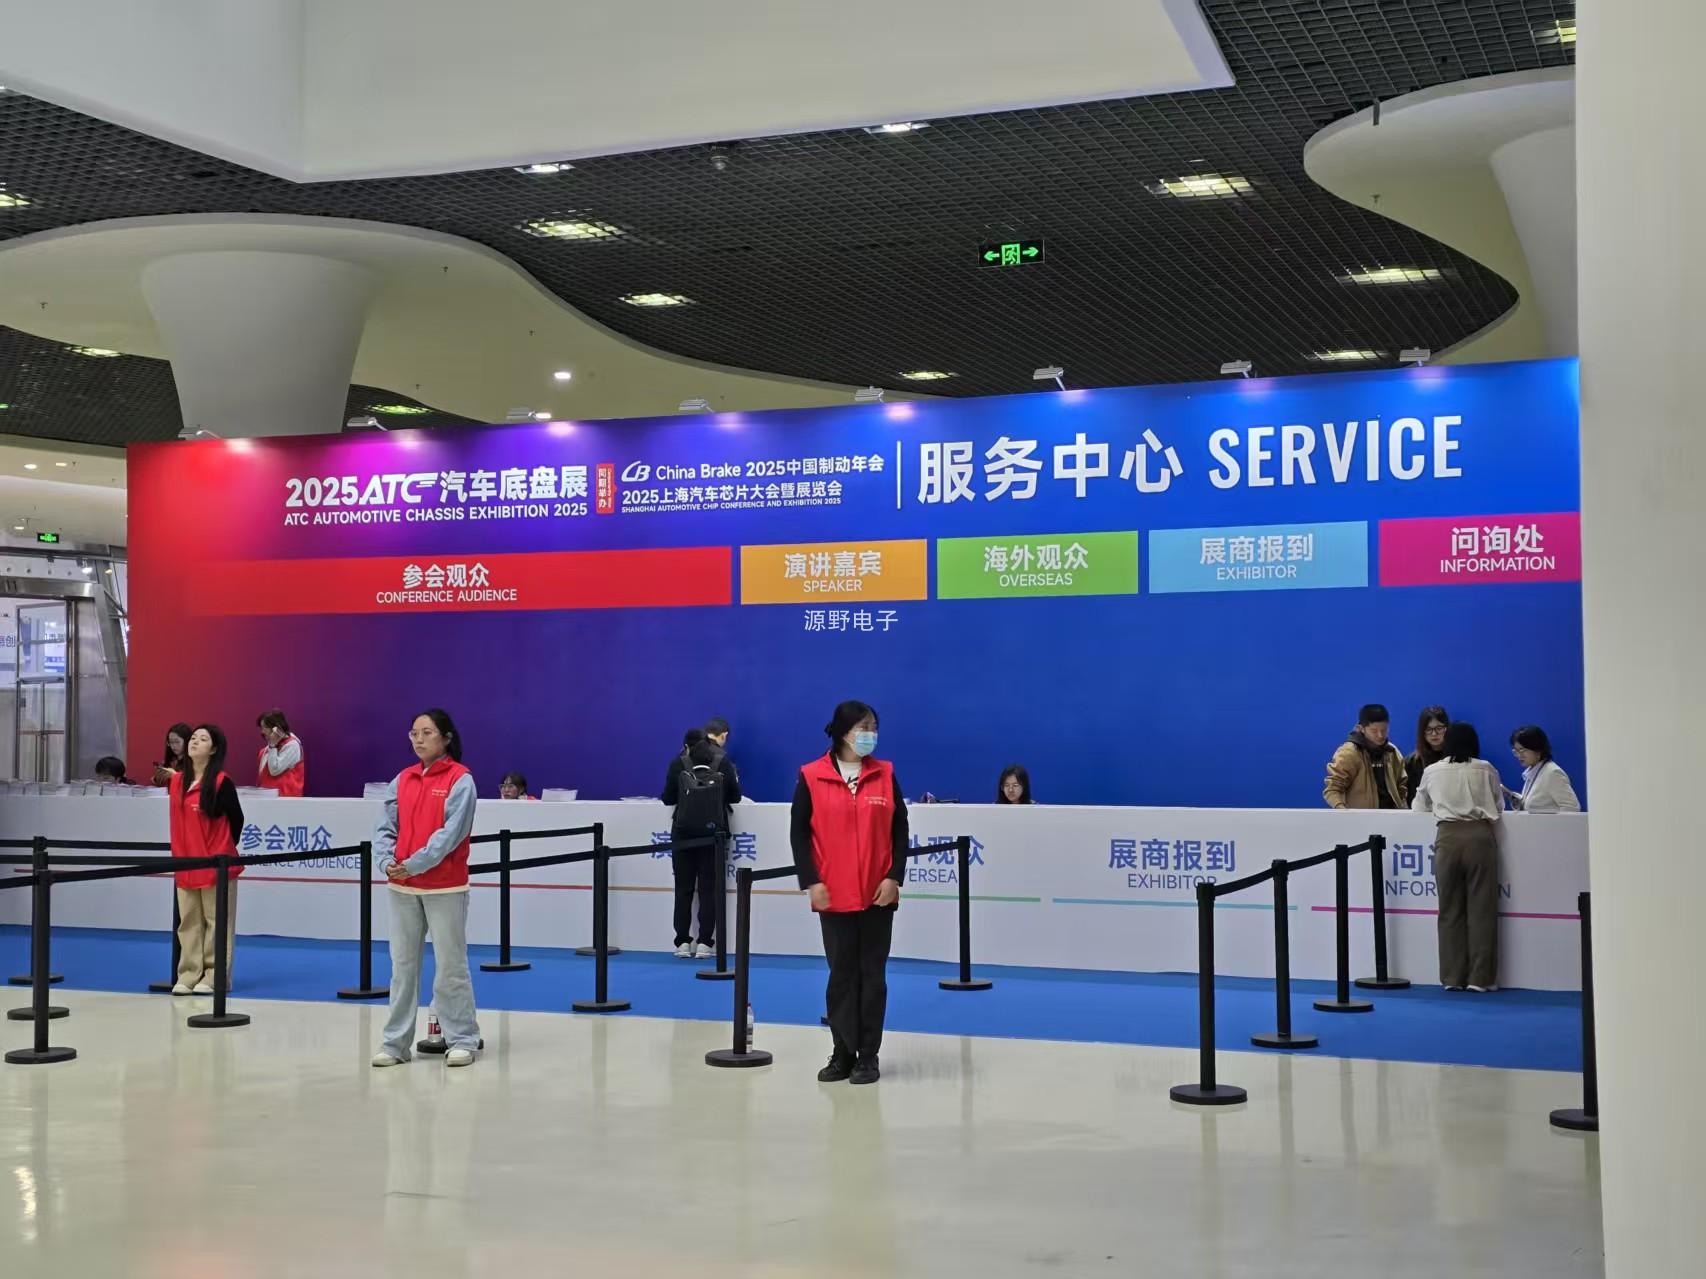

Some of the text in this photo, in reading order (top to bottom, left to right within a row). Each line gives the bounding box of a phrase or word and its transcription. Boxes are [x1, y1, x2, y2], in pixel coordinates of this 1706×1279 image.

[656, 464, 696, 480] China
[700, 462, 741, 478] Brake
[746, 454, 885, 477] 2025中国制动年会
[917, 415, 1462, 504] 服务中心 SERVICE
[621, 497, 841, 513] SHANGHAI AUTOMOTIVE CHIP CONFERENCE AND EXHIBITION 2025
[622, 480, 842, 504] 2025上海汽车芯片大会暨展览会
[284, 503, 587, 526] ATC AUTOMOTIVE CHASSIS EXHIBITION 2025
[1200, 533, 1313, 565] 展商报到
[1451, 524, 1545, 556] 问询处
[783, 550, 882, 579] 演讲嘉宾
[983, 543, 1089, 573] 海外观众
[1440, 556, 1556, 573] INFORMATION
[402, 563, 490, 589] 参会观众
[803, 579, 862, 593] SPEAKER
[999, 573, 1073, 587] OVERSEAS
[1216, 565, 1297, 581] EXHIBITOR
[376, 588, 517, 604] CONFERENCE AUDIENCE
[241, 824, 332, 851] 参会观众
[1109, 838, 1236, 872] 展商报到
